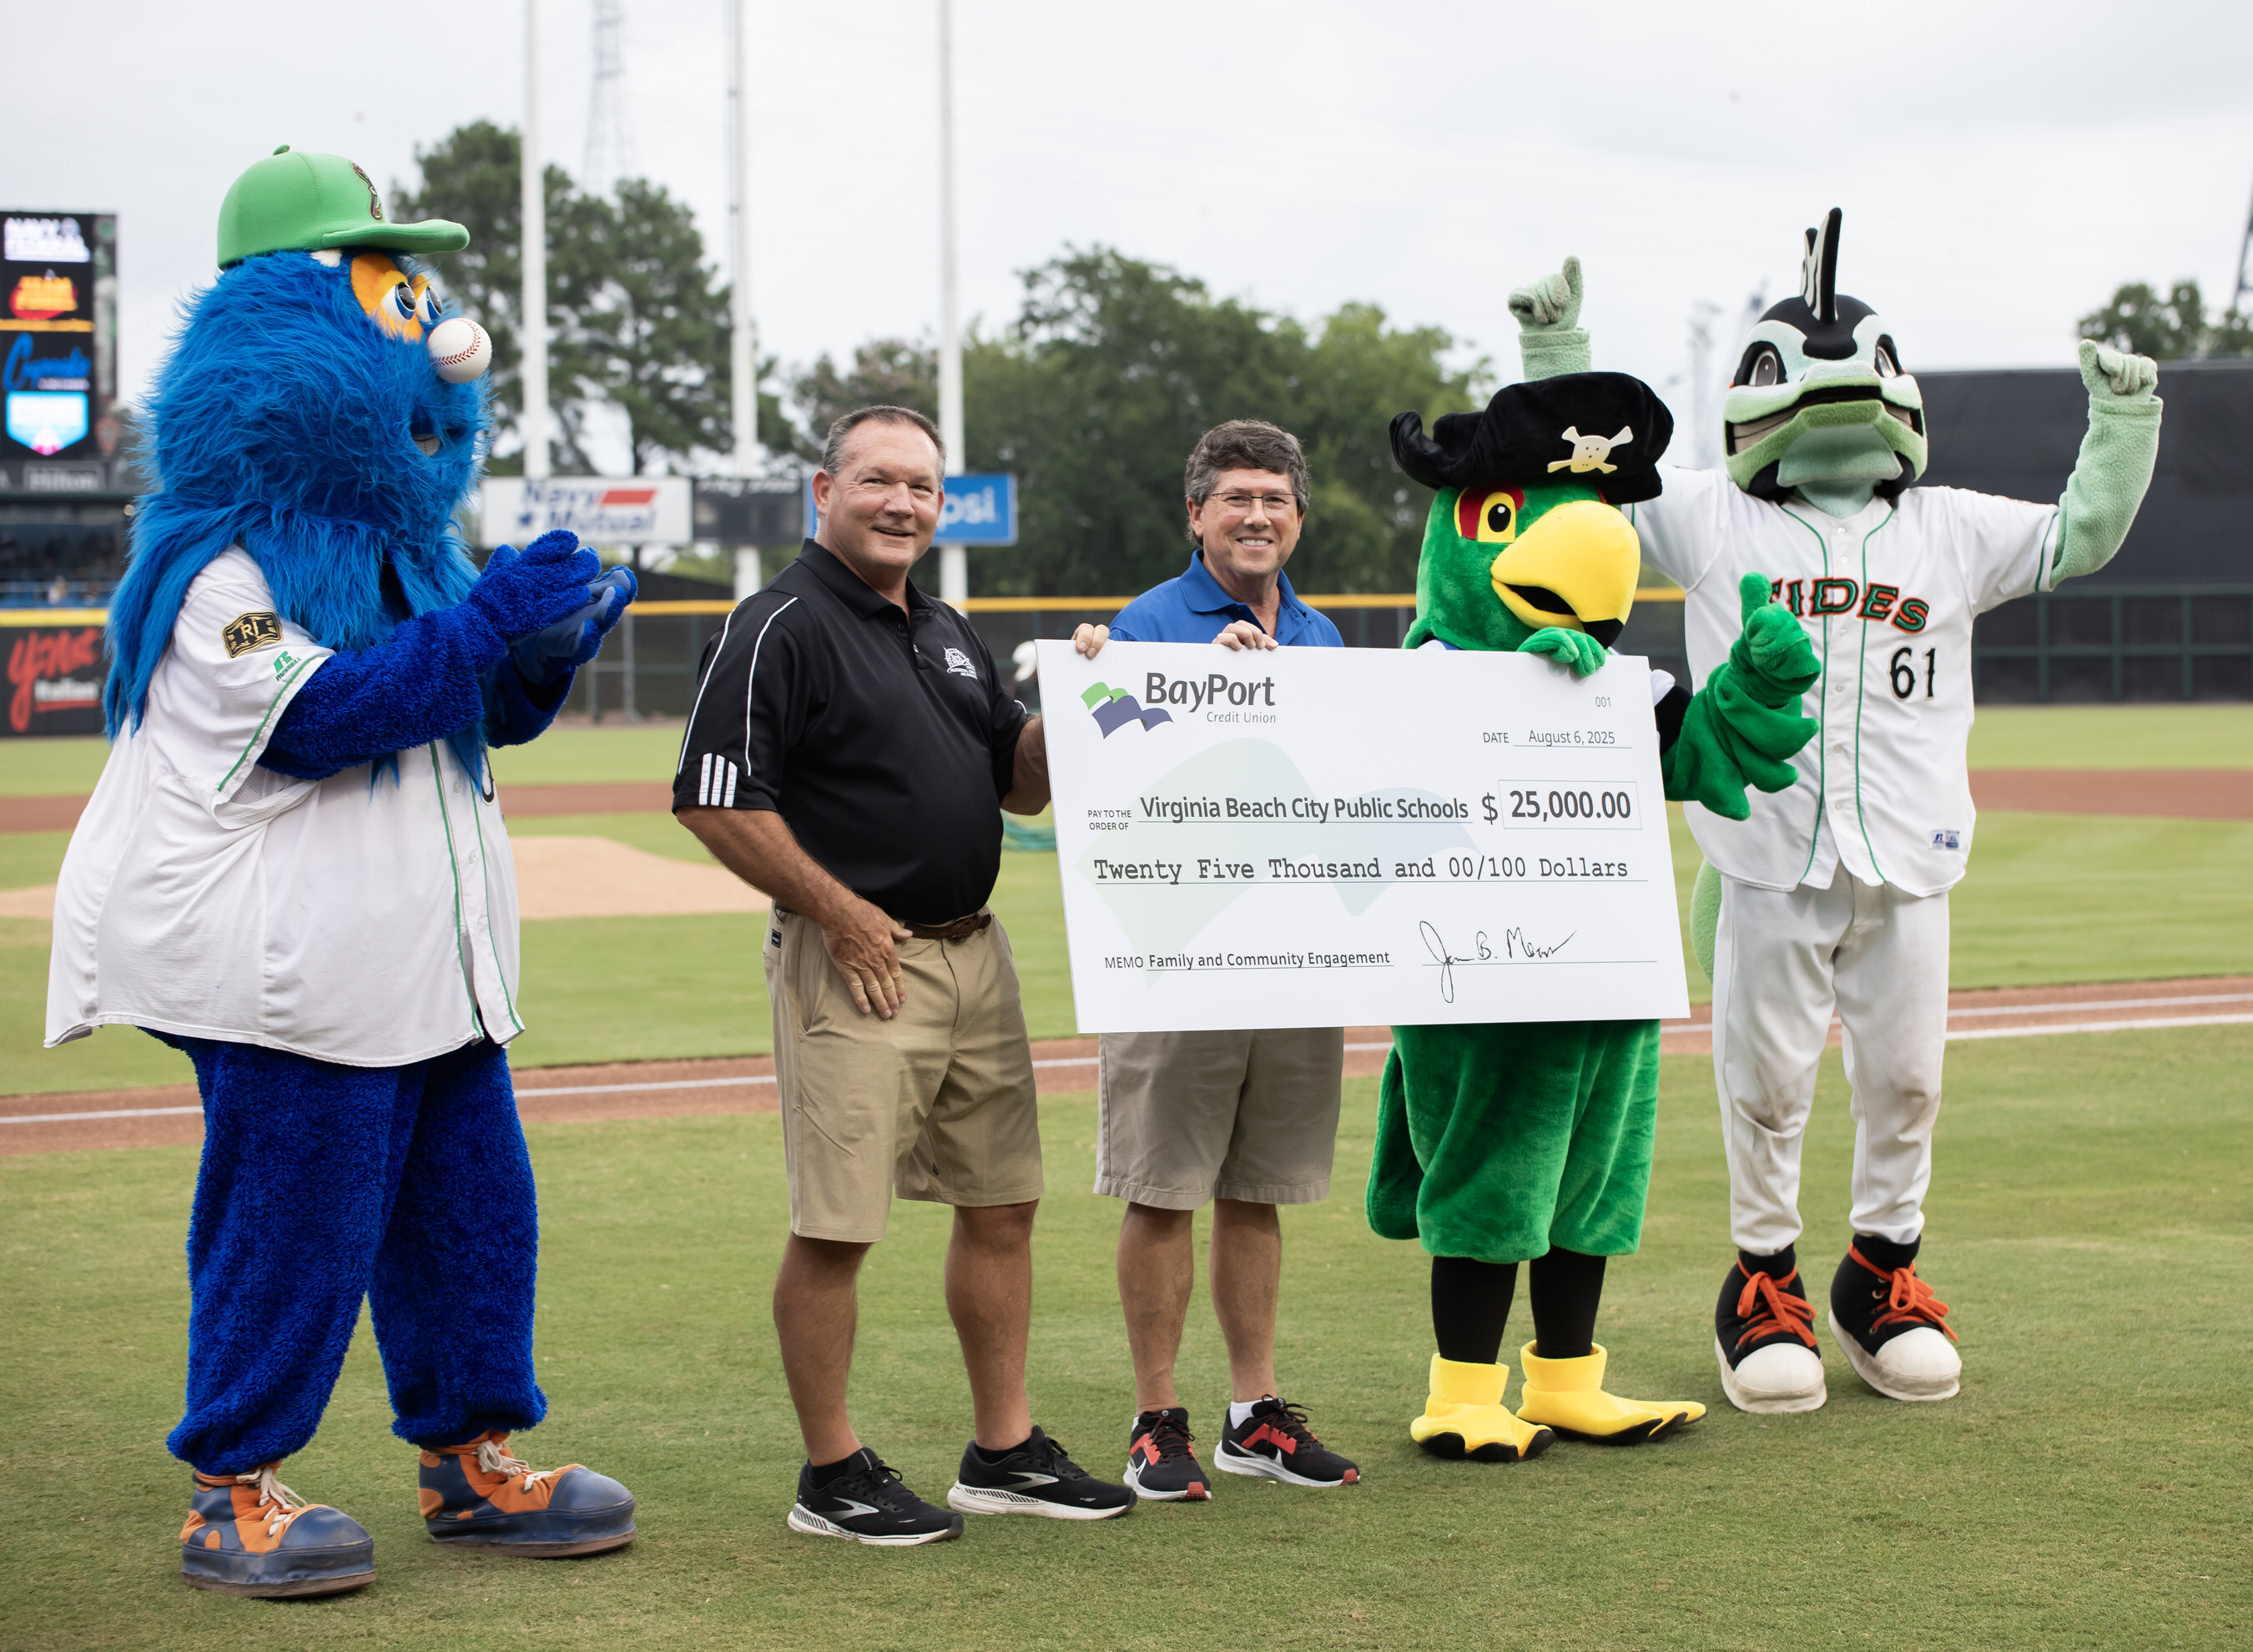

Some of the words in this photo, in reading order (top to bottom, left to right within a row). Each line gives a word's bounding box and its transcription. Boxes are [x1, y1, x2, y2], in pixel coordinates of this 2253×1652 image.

[935, 485, 995, 532] psi
[1889, 646, 1937, 700] 61
[1146, 672, 1276, 713] BayPort
[1595, 696, 1611, 708] 001
[1207, 711, 1239, 723] Credit
[1243, 712, 1276, 723] Union
[1482, 732, 1510, 743] DATE
[1528, 730, 1573, 748] August
[1574, 730, 1585, 745] 6,
[1586, 730, 1615, 743] 2025
[1087, 809, 1102, 818] PAY
[1103, 809, 1115, 818] TO
[1115, 809, 1132, 818] THE
[1139, 795, 1221, 823] Virginia
[1225, 796, 1288, 818] Beach
[1291, 796, 1329, 823] City
[1333, 797, 1394, 818] Public
[1396, 797, 1469, 819] Schools
[1509, 789, 1631, 823] 25,000.00
[1088, 822, 1117, 831] ORDER
[1117, 822, 1130, 831] OF
[1093, 859, 1182, 885] Twenty
[1197, 857, 1255, 879] Five
[1268, 857, 1383, 879] Thousand
[1394, 857, 1437, 879] and
[1448, 854, 1526, 881] 00/100
[1538, 857, 1628, 878] Dollars
[1104, 956, 1144, 970] MEMO
[1148, 953, 1194, 971] Family
[1197, 952, 1223, 967] and
[1227, 951, 1304, 970] Community
[1308, 951, 1391, 969] Engagement
